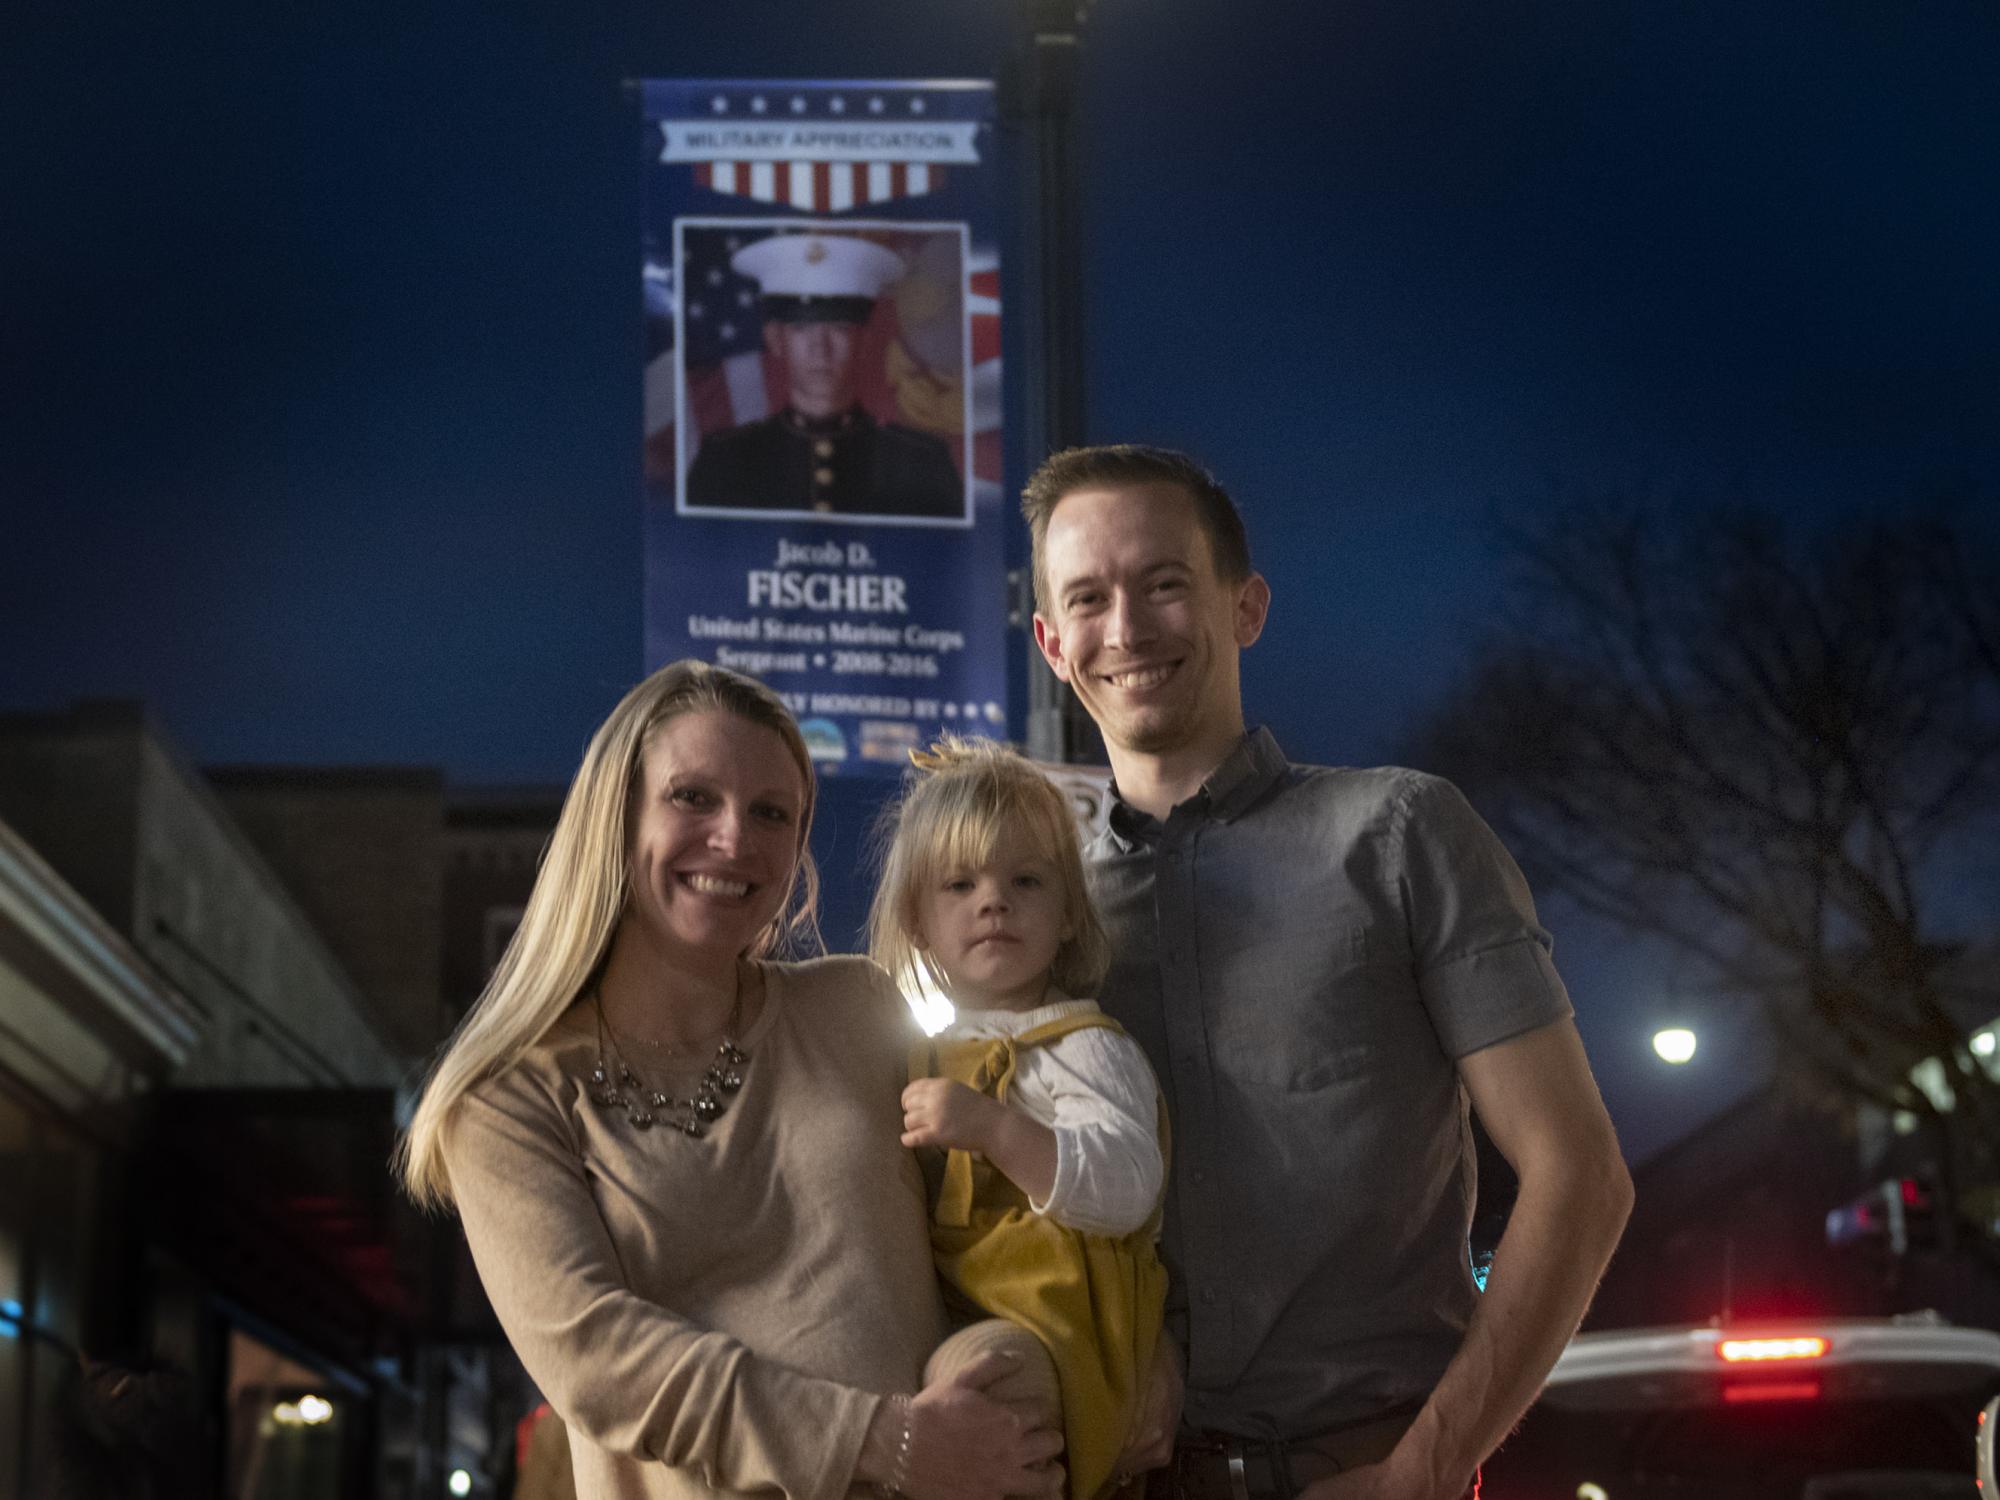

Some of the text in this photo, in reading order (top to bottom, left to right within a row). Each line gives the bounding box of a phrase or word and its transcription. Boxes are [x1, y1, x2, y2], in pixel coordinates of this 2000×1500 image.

[685, 130, 953, 149] MILITARY APPRECIATION
[774, 538, 876, 567] Jacob D.
[747, 569, 908, 613] FISCHER
[688, 614, 966, 652] United States Marine Corps
[810, 693, 912, 717] HONORED
